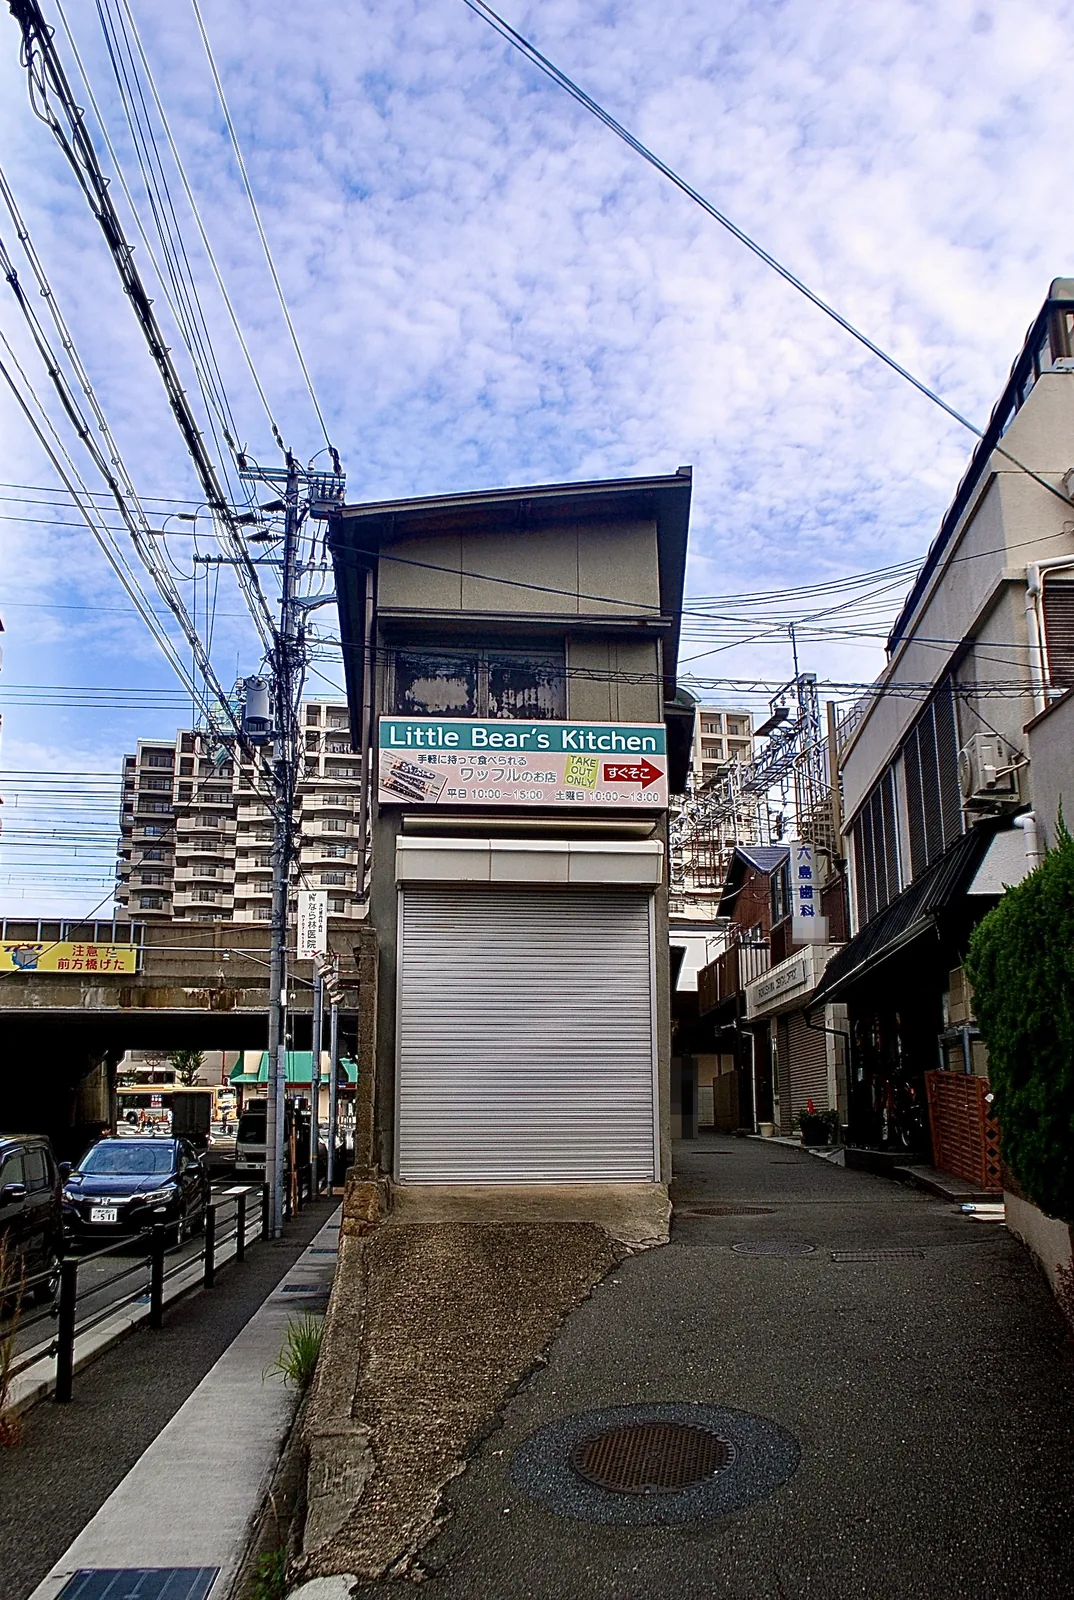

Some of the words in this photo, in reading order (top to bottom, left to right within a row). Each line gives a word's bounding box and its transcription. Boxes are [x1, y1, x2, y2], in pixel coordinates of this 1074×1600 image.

[389, 725, 459, 747] Little
[471, 727, 550, 749] Bear's
[562, 729, 656, 751] Kitchen
[417, 754, 527, 766] 手軽に持って食べられる
[570, 755, 597, 768] TAKE
[460, 768, 556, 783] ワッフルのお店
[570, 765, 593, 777] OUT
[607, 767, 651, 779] すぐそこ
[566, 775, 594, 788] ONLY
[447, 788, 467, 799] 平日
[58, 958, 125, 970] 前方橋げた
